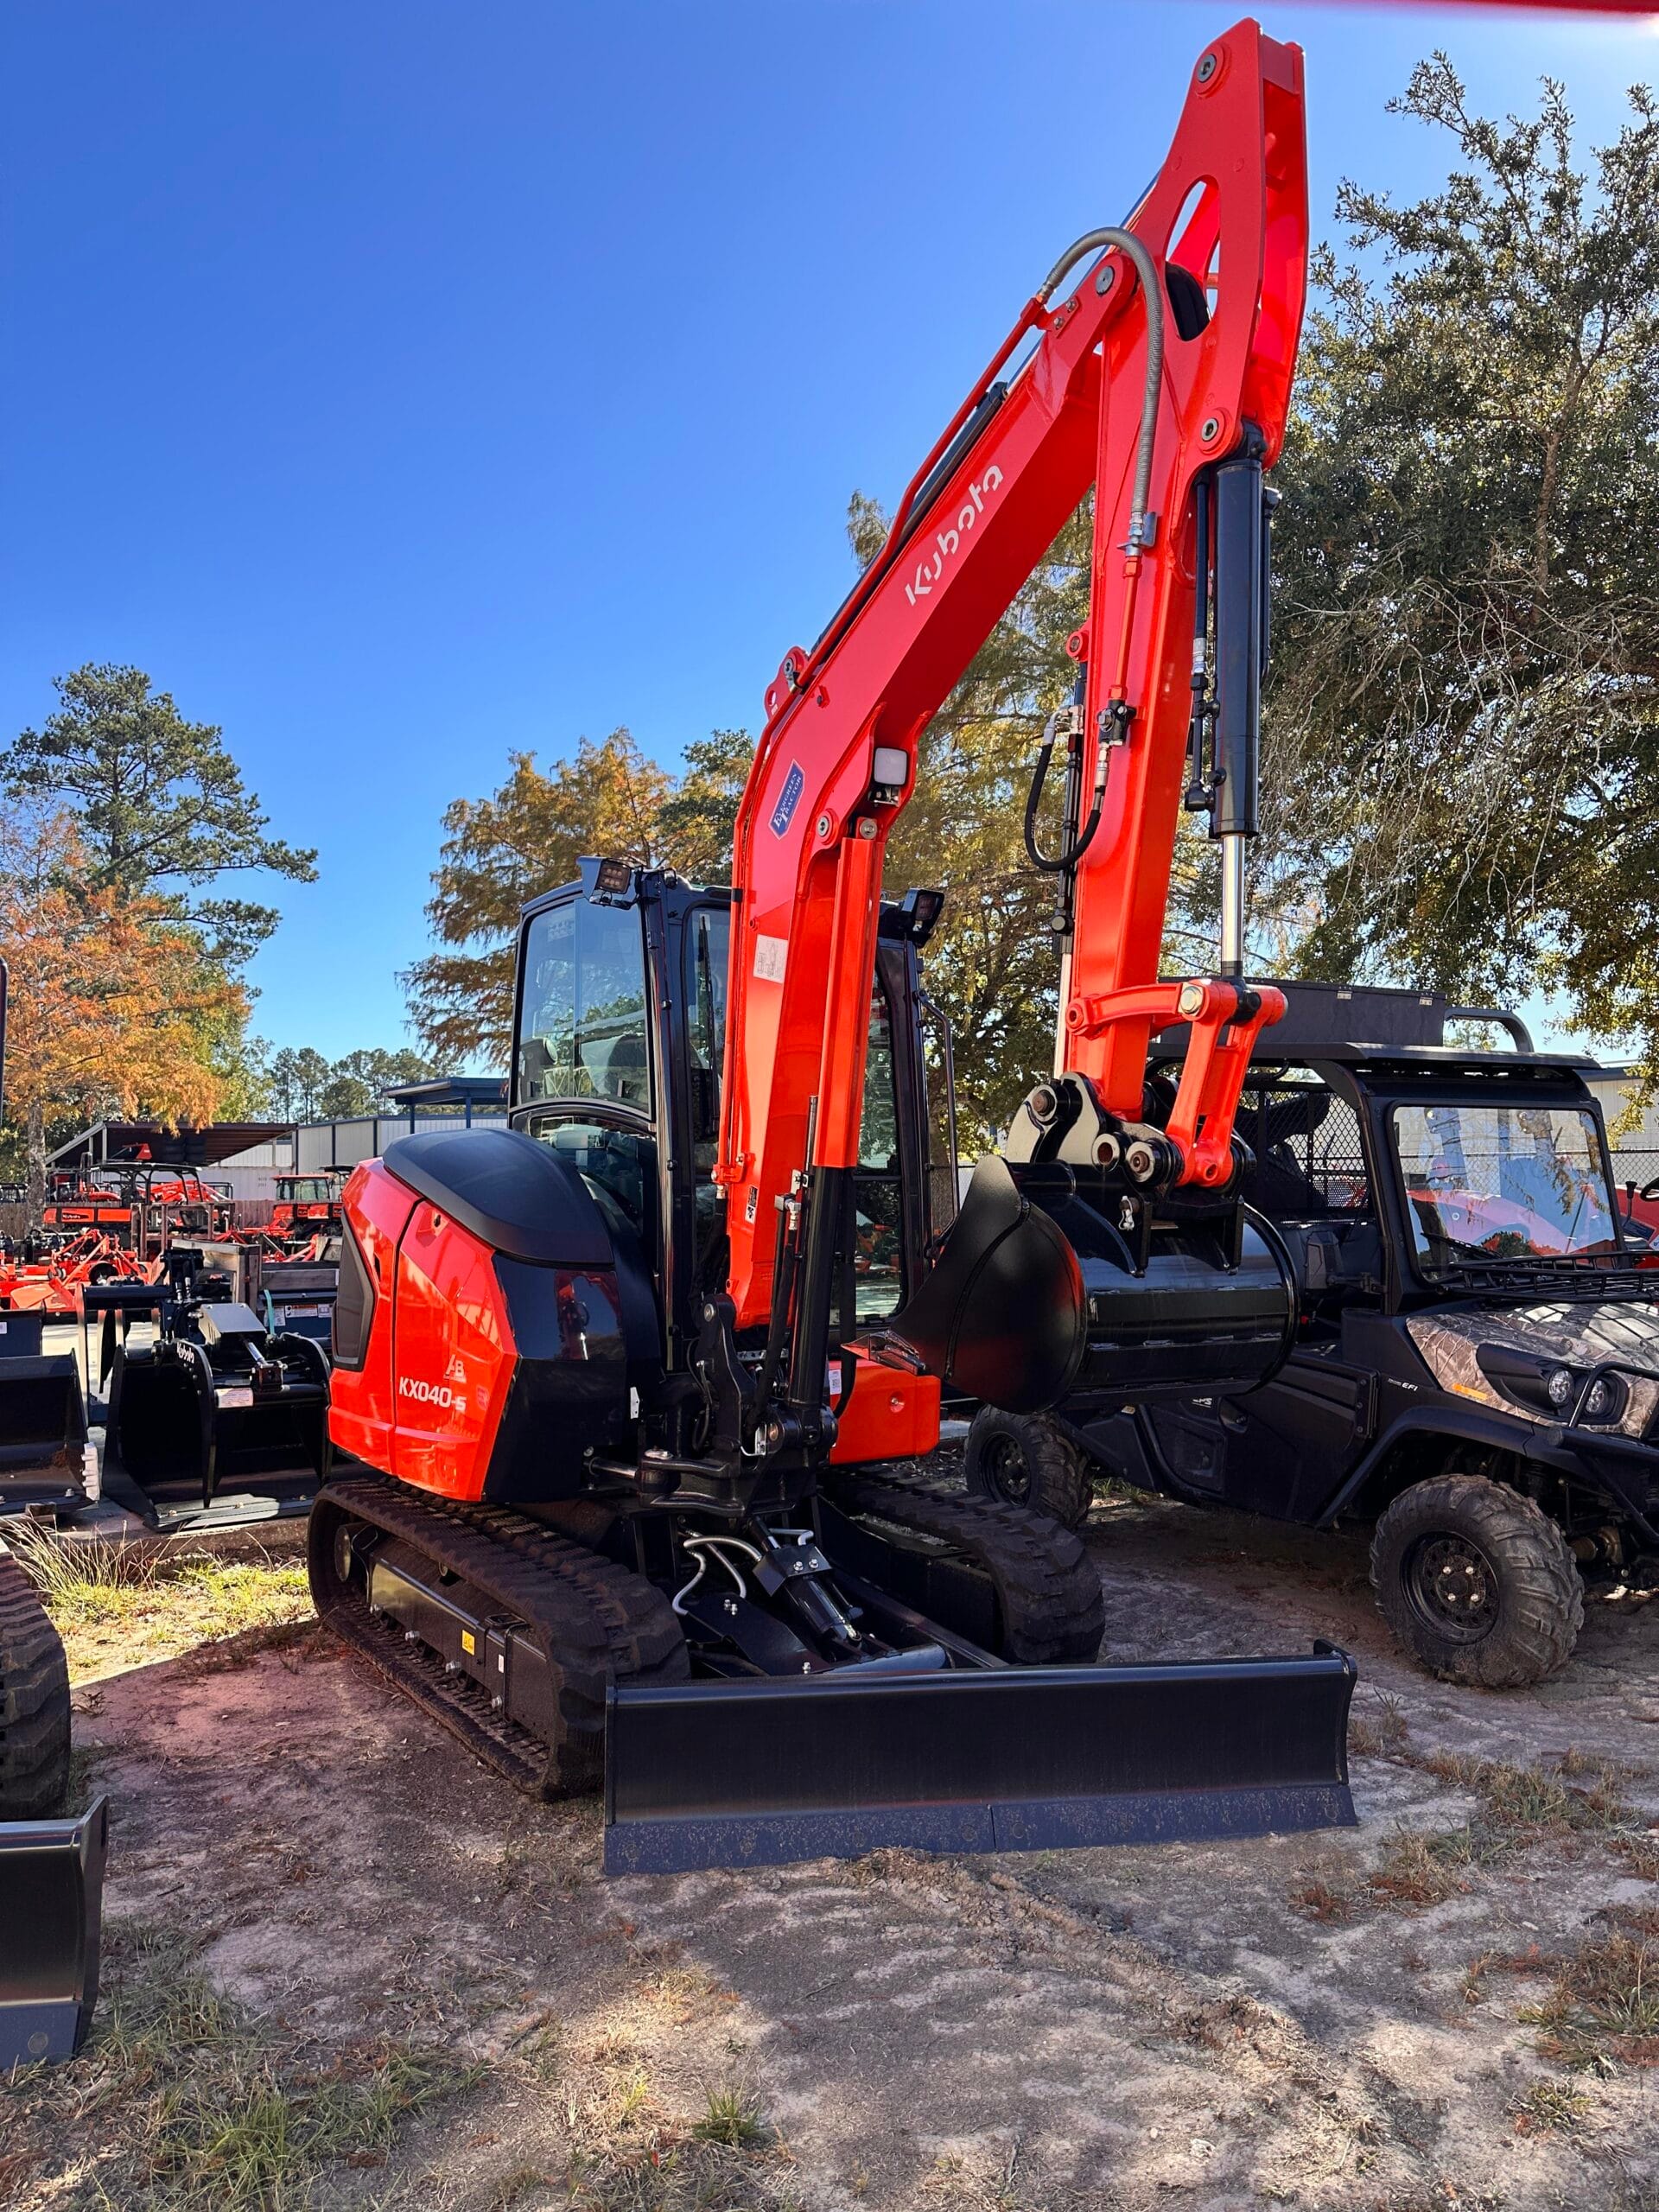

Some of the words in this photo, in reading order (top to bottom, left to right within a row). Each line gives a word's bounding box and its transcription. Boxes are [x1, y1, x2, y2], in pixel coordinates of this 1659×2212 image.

[905, 464, 1004, 607] Kubota
[780, 775, 802, 823] TRACTOR
[398, 1376, 467, 1413] KX040-5
[1402, 1382, 1419, 1392] EFI
